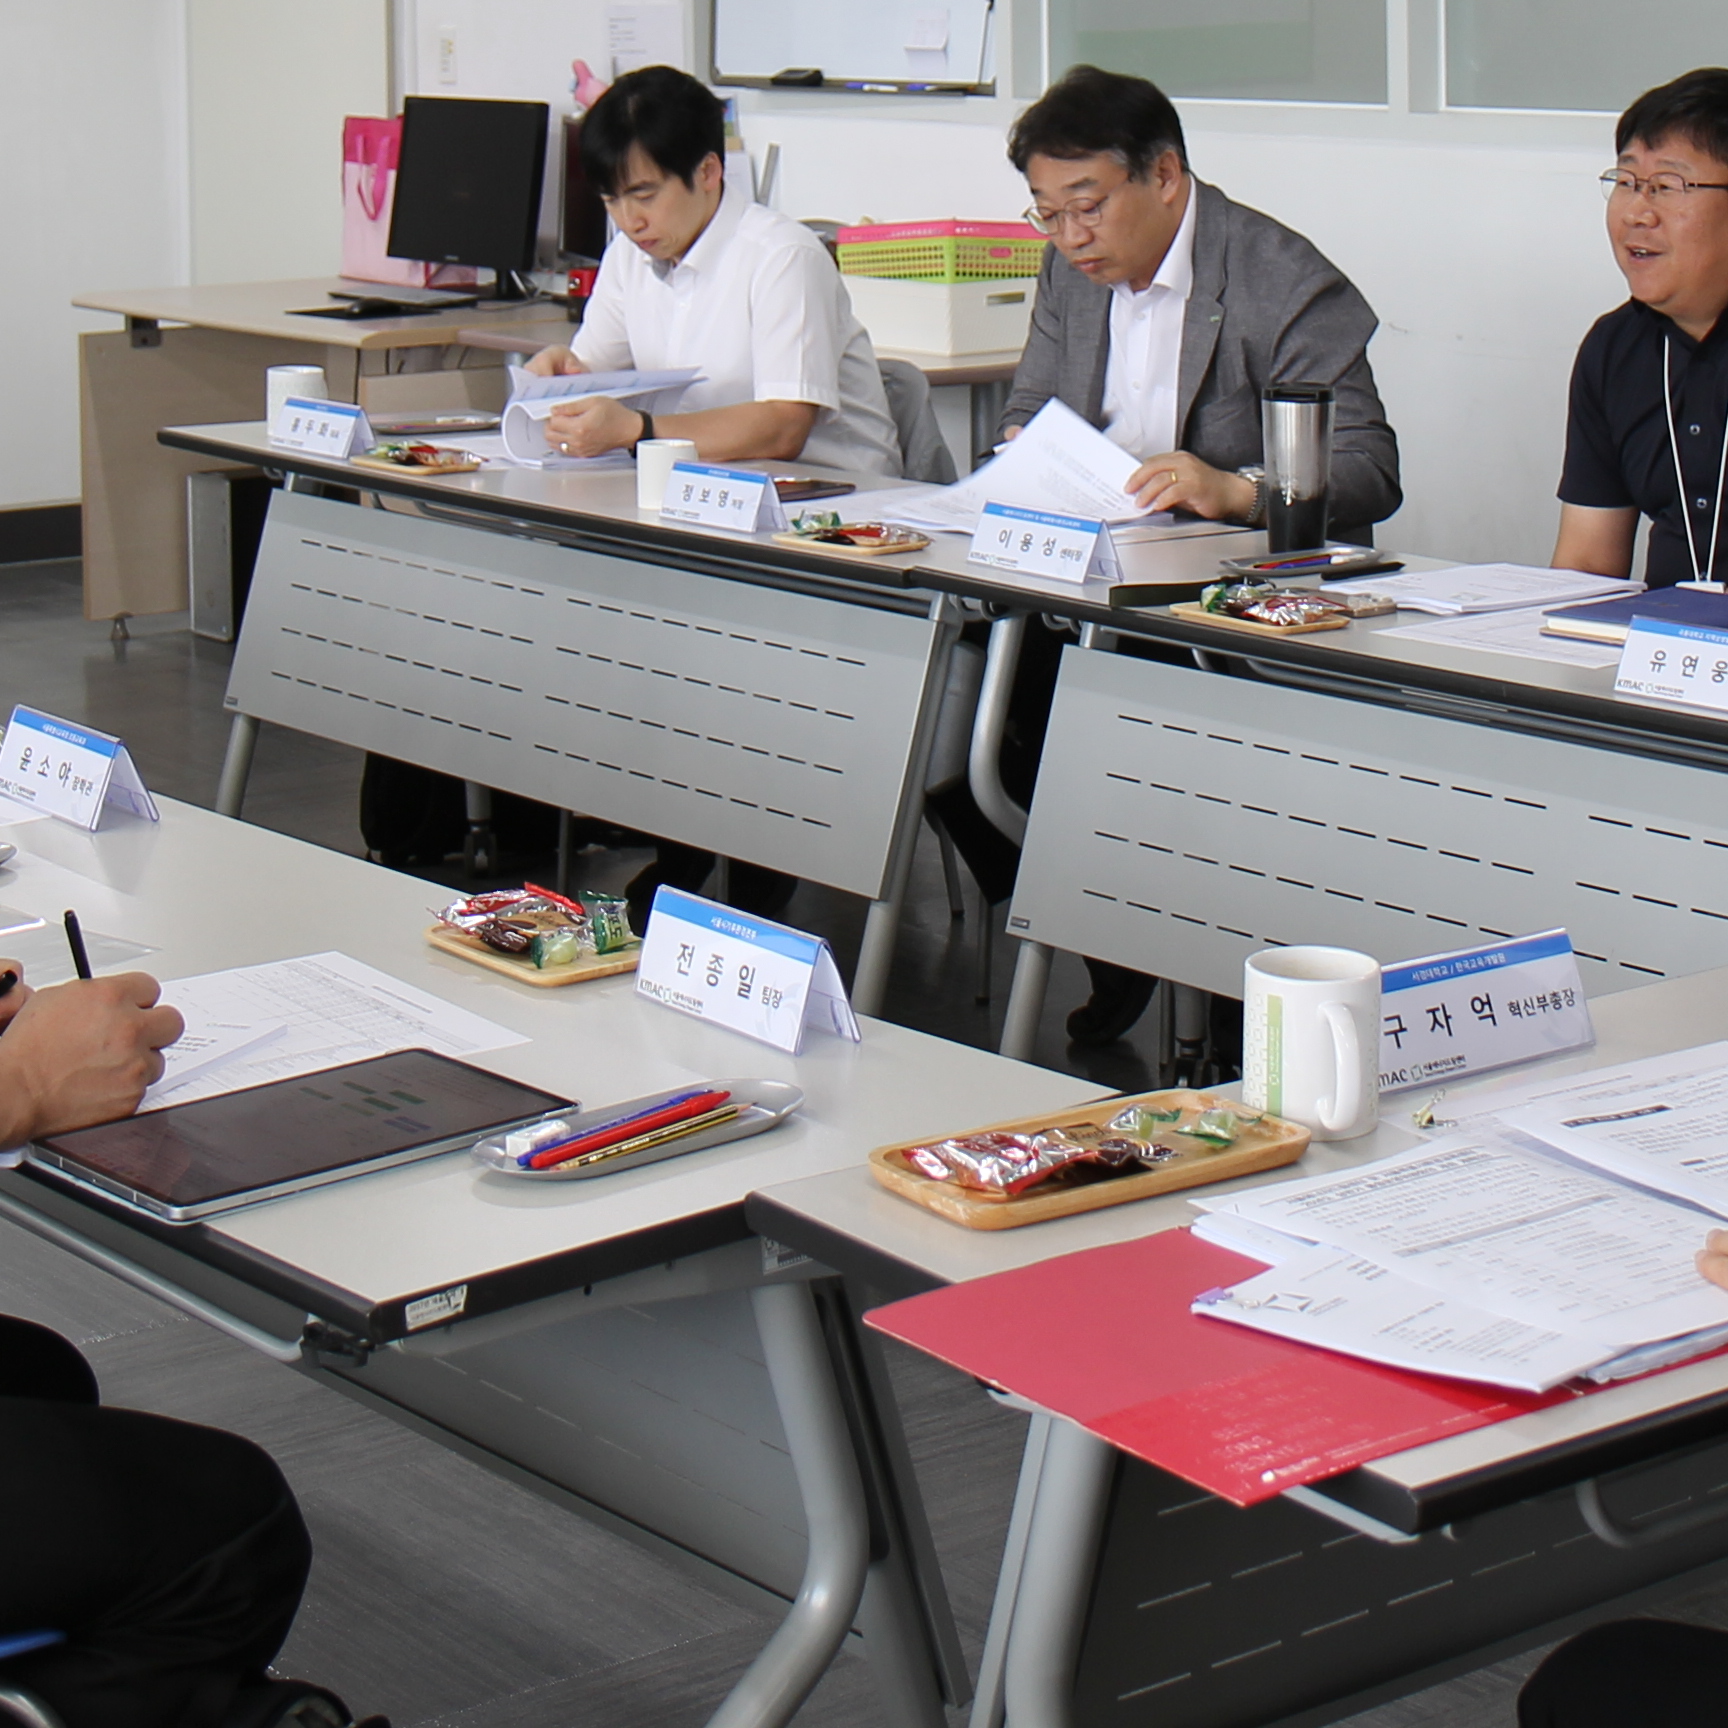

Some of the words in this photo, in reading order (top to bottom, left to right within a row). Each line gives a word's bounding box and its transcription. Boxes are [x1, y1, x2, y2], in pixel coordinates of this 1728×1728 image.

[682, 483, 694, 502] 정
[698, 487, 711, 503] 보
[998, 528, 1013, 549] 이
[1020, 532, 1034, 553] 용
[1042, 537, 1057, 557] 성
[1060, 547, 1084, 563] 센터장
[1650, 649, 1667, 673] 유
[1681, 654, 1699, 679] 연
[1711, 660, 1728, 683] 웅
[19, 746, 33, 772] 윤
[37, 754, 50, 778] 소
[676, 942, 696, 976] 전
[705, 952, 724, 988] 종
[737, 964, 756, 1000] 일
[762, 984, 784, 1010] 팀장
[1455, 952, 1507, 972] 한국교육개발원
[1383, 1014, 1407, 1049] 구
[1425, 1003, 1454, 1037] 자
[1470, 992, 1498, 1027] 억
[1507, 987, 1576, 1019] 혁신부총장
